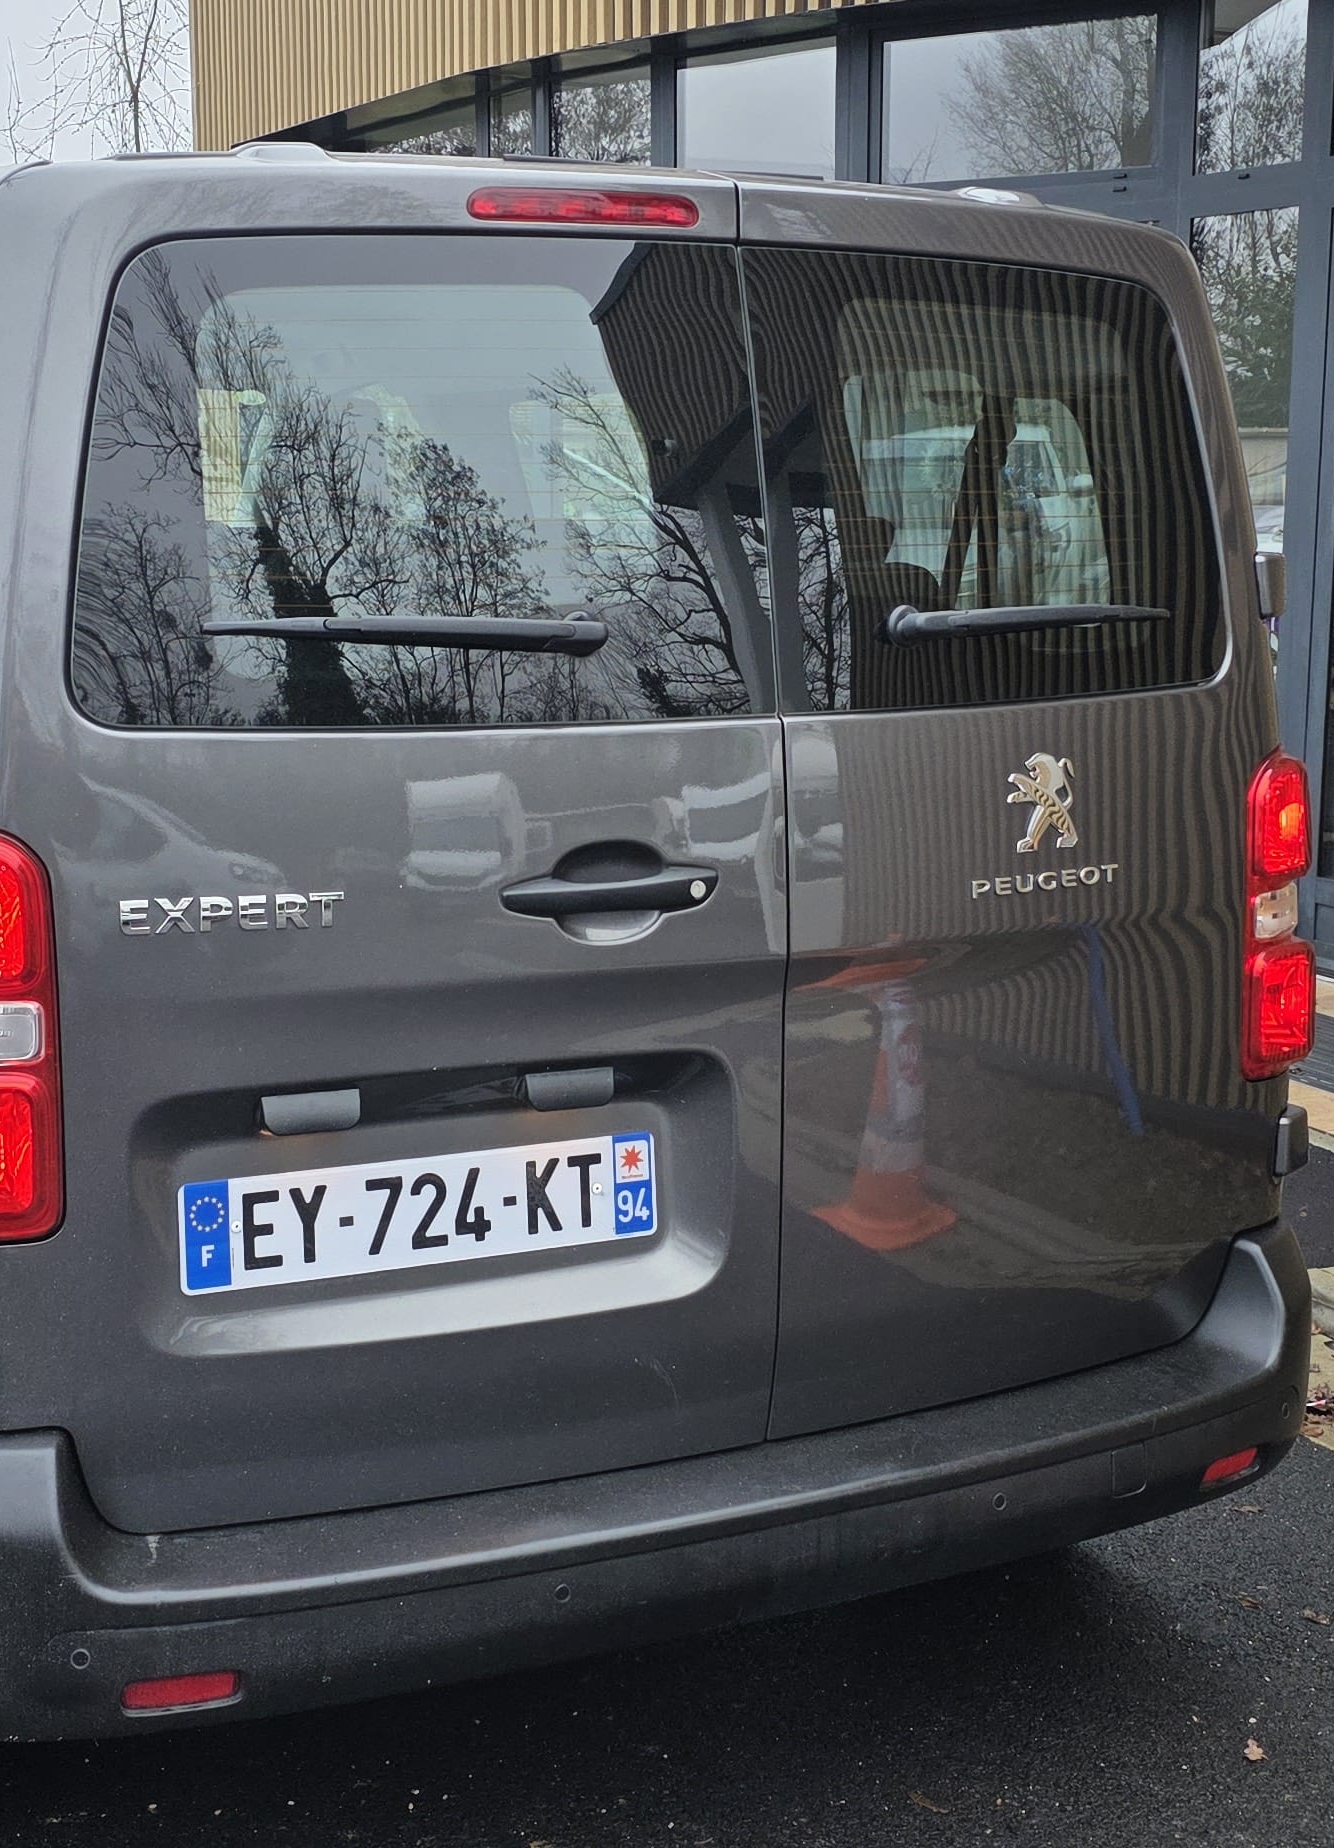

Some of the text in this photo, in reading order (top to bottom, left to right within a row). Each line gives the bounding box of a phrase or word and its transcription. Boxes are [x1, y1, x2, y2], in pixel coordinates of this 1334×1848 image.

[971, 863, 1119, 900] PEUGEOT
[119, 890, 345, 936] EXPERT
[240, 1153, 603, 1271] EY-724-KT
[617, 1187, 651, 1224] 94
[201, 1244, 216, 1268] F
